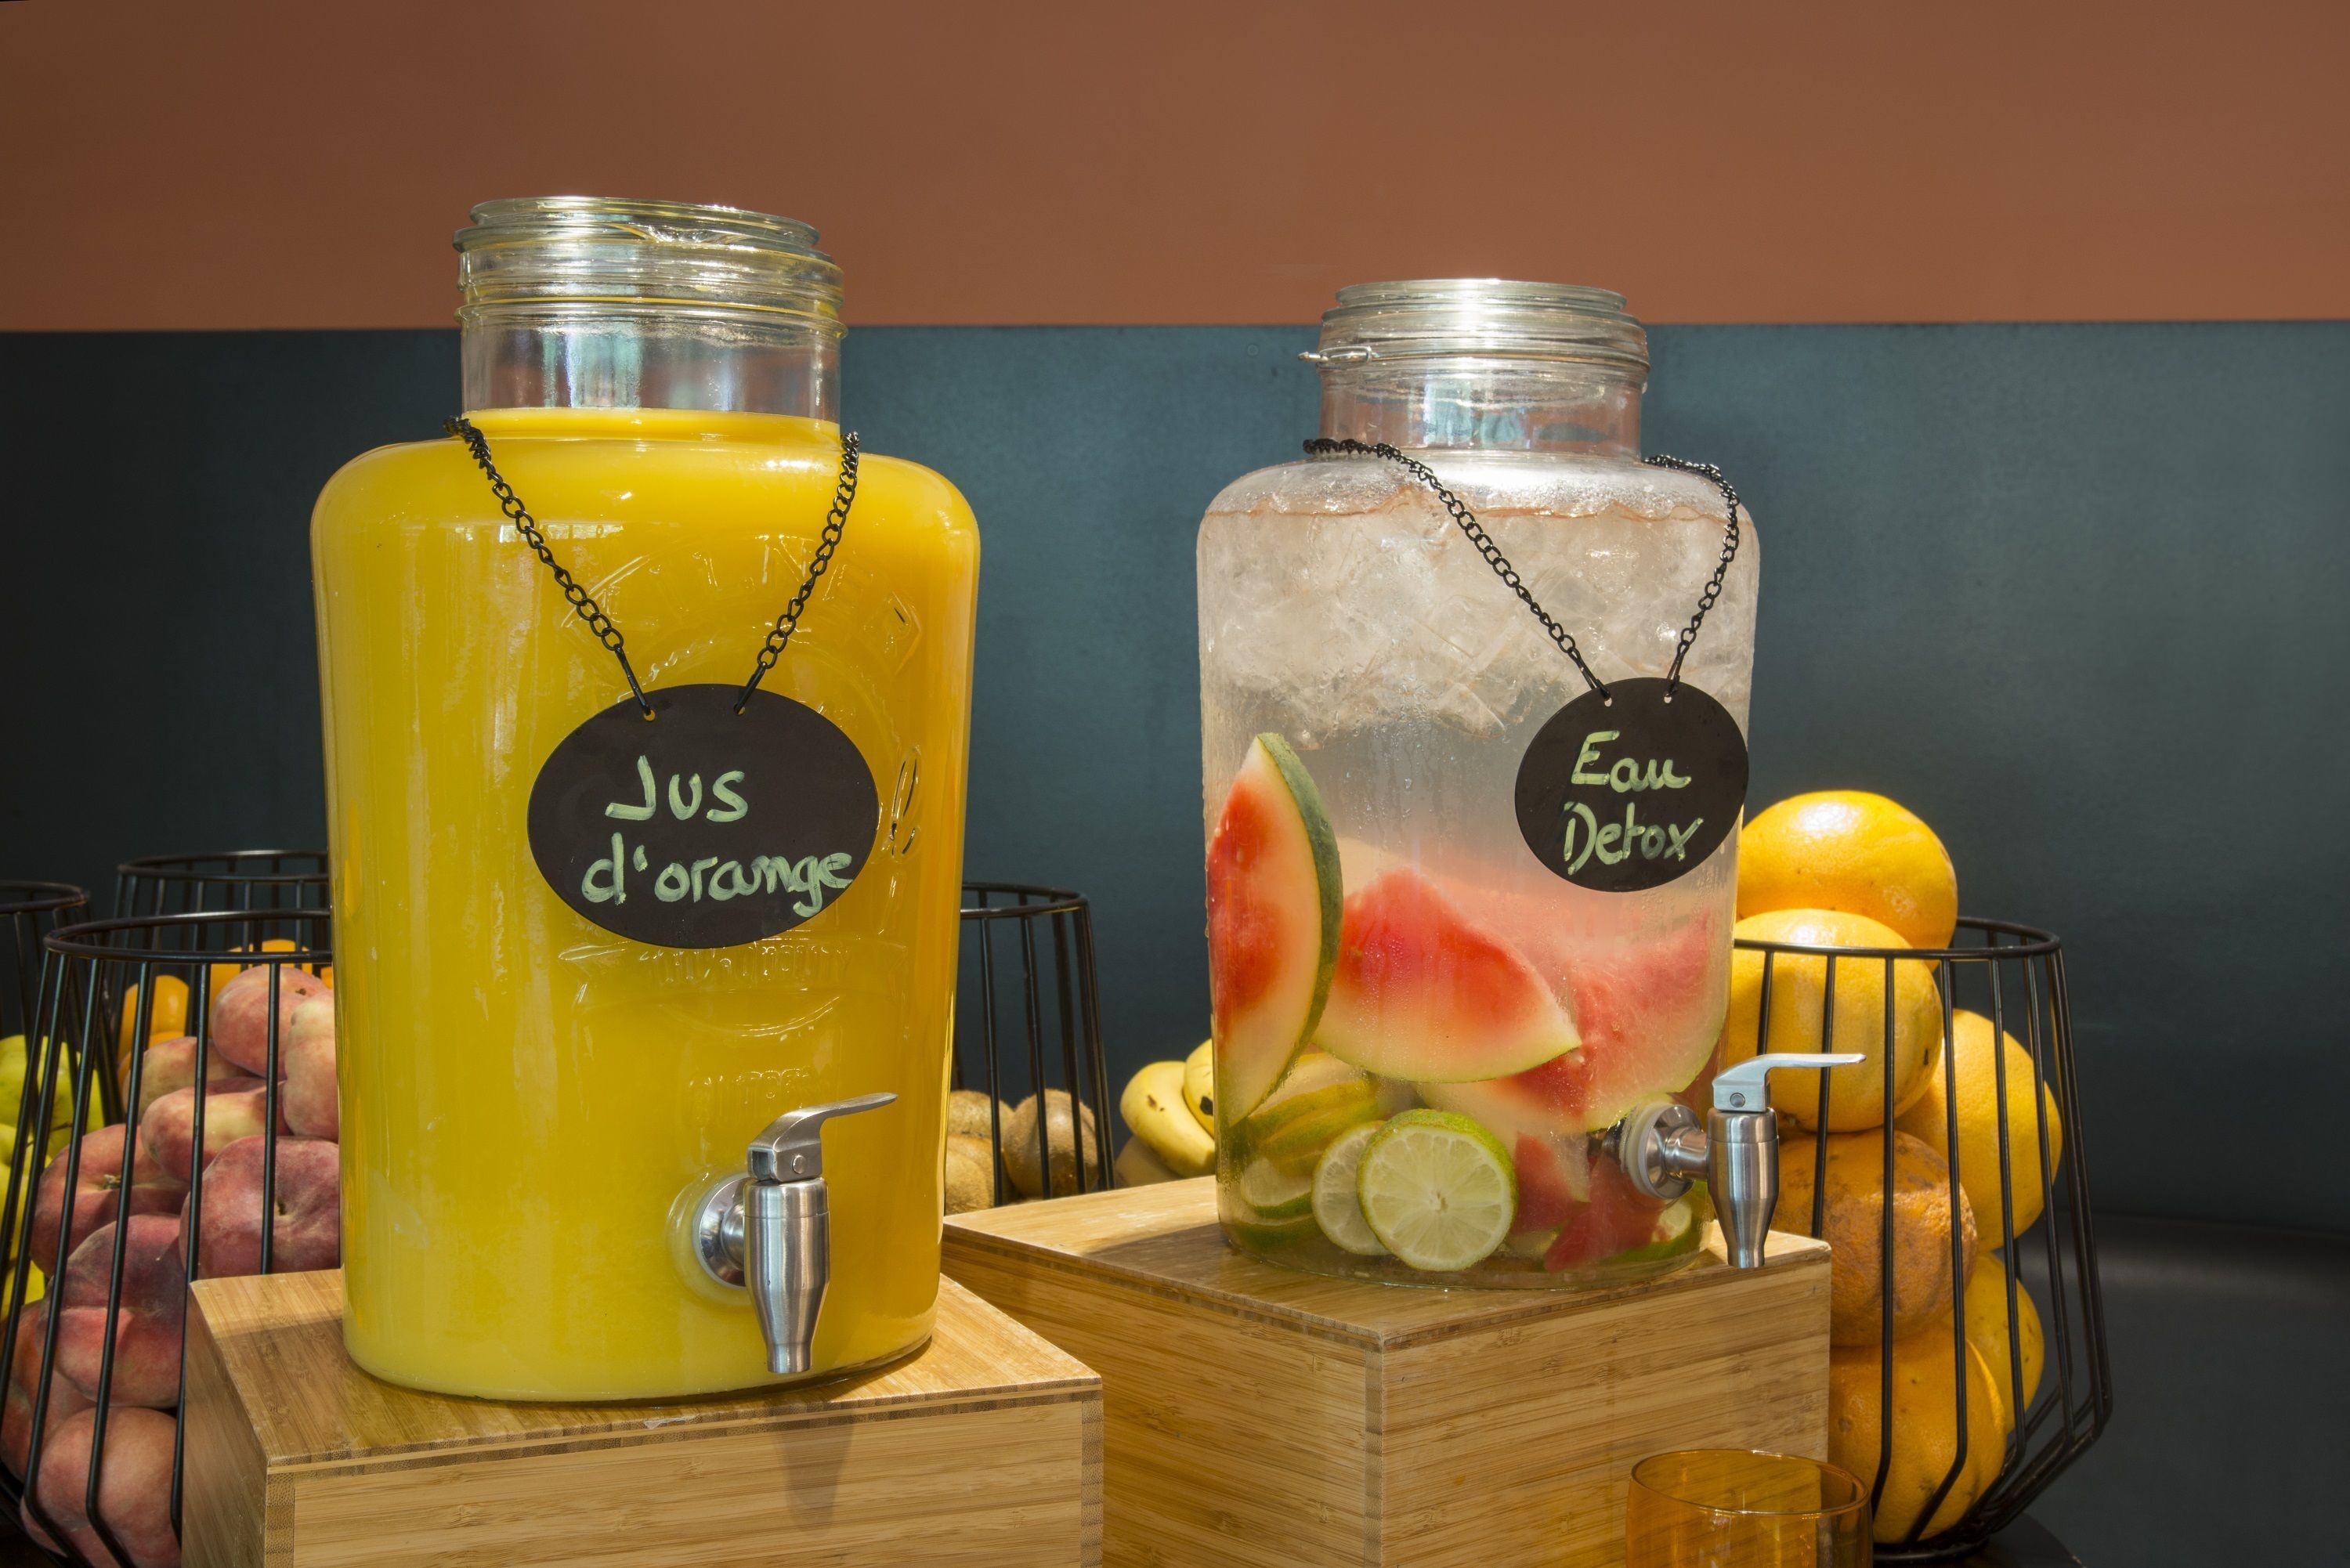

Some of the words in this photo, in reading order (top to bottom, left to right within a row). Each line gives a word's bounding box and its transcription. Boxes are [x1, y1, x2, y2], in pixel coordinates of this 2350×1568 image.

[605, 755, 749, 822] Jus
[1571, 730, 1692, 793] Eau
[1564, 801, 1704, 876] Detox
[581, 833, 854, 918] d'orange
